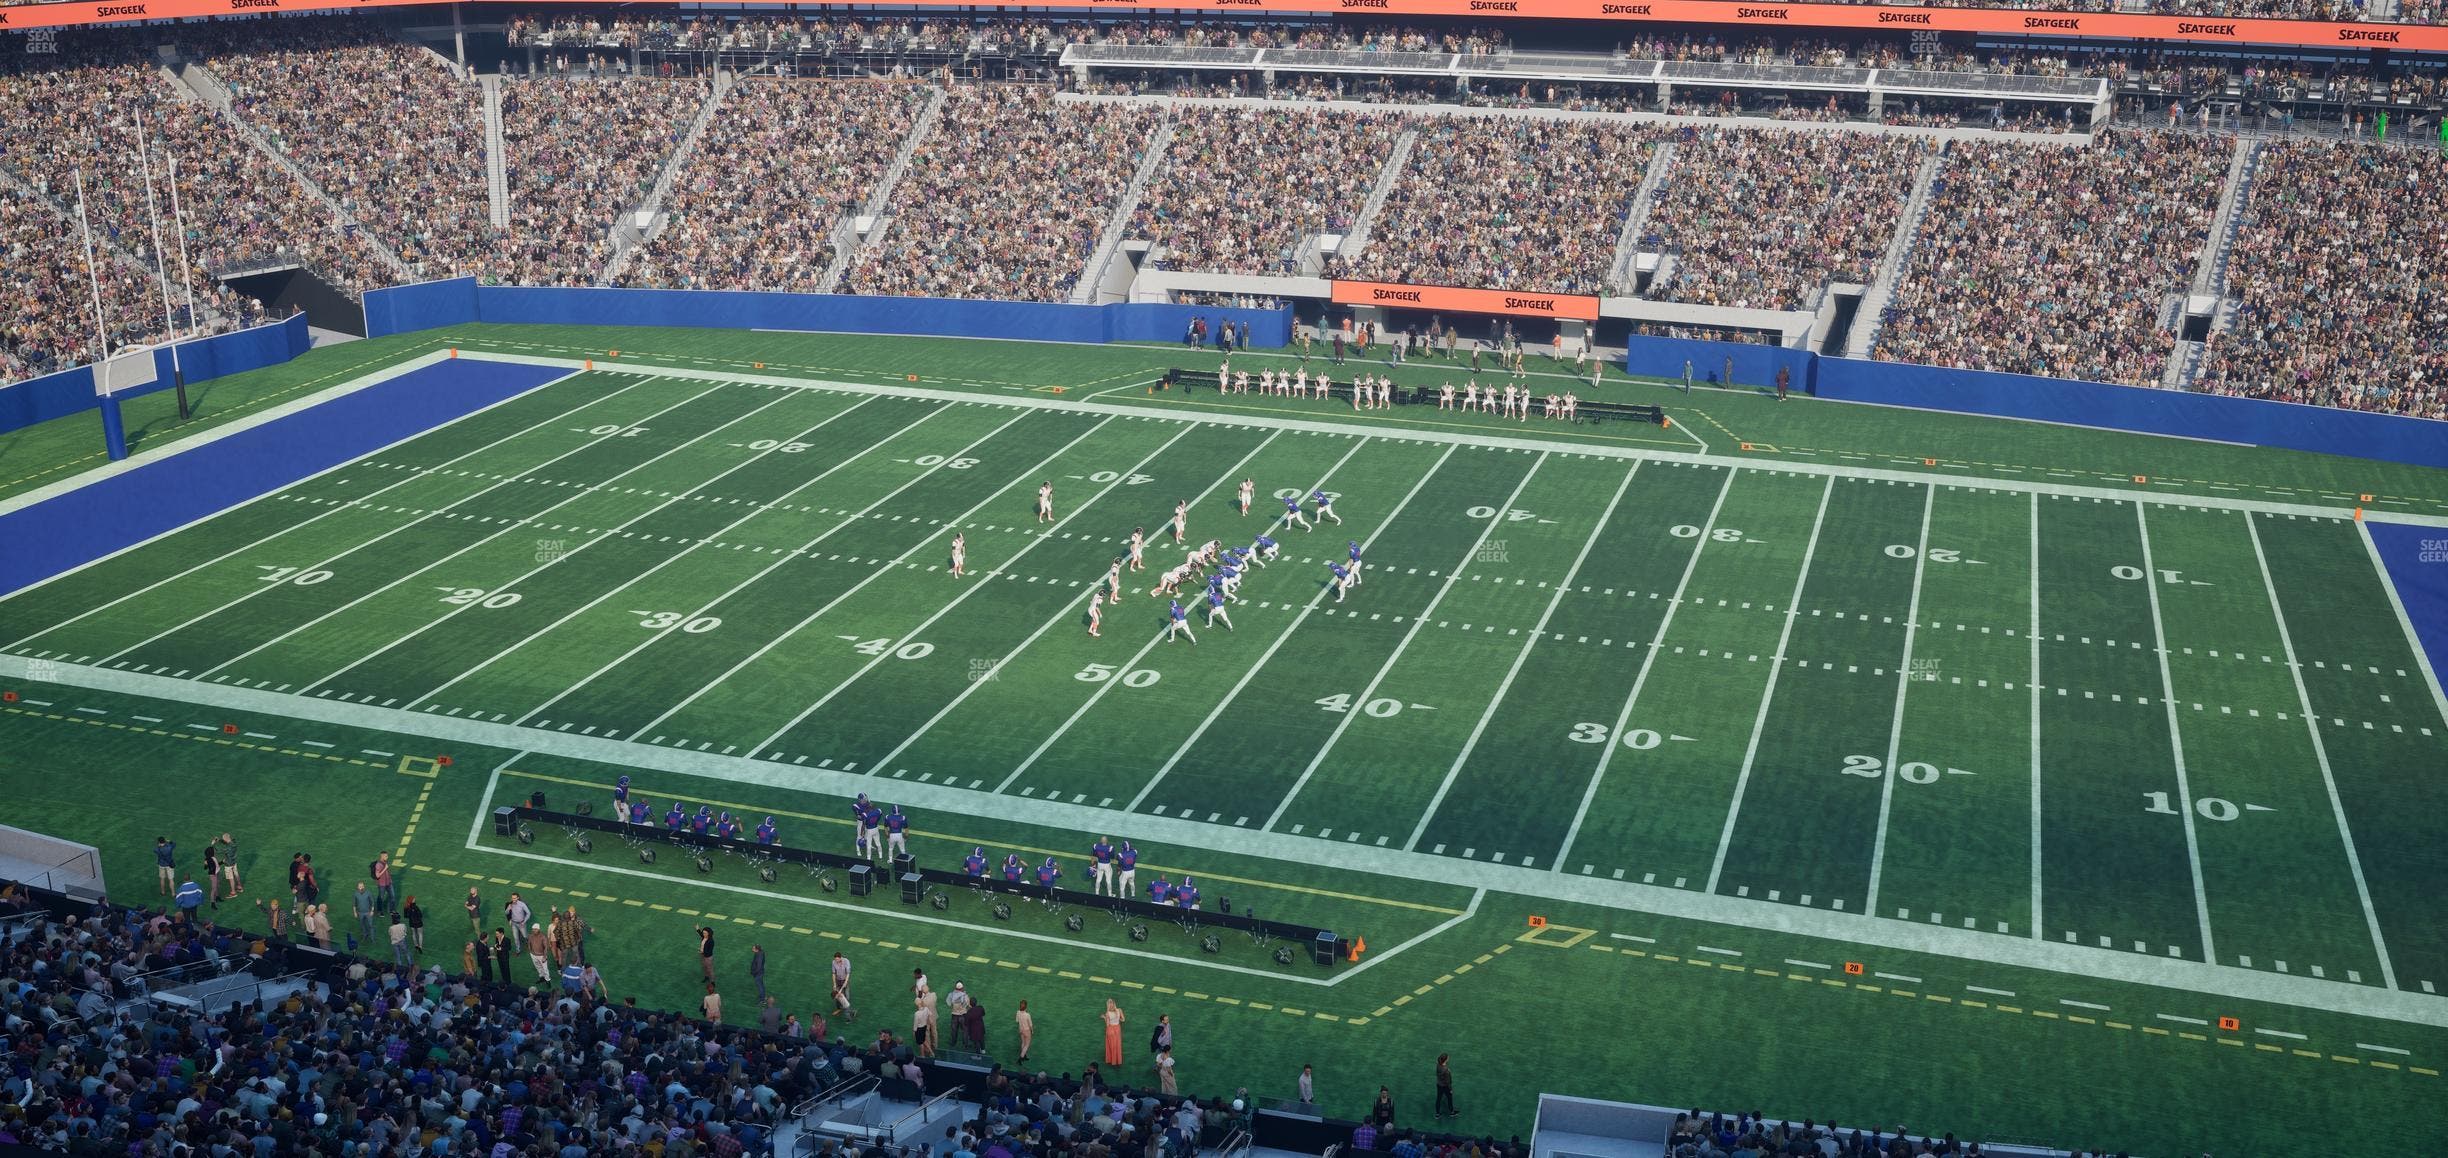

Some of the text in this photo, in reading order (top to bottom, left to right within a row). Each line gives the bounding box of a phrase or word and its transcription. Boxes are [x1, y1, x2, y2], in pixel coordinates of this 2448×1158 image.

[97, 4, 146, 17] SEATGEEK
[1342, 0, 1388, 8] SEATGEEK
[1470, 0, 1517, 11] SEATGEEK
[1602, 4, 1651, 15] SEATGEEK
[1737, 7, 1788, 19] SEATGEEK
[1878, 12, 1931, 24] SEATGEEK
[2024, 17, 2079, 30] SEATGEEK
[2178, 22, 2235, 36] SEATGEEK
[2339, 29, 2400, 43] SEATGEEK
[1373, 288, 1421, 302] SEATGEEK
[1505, 297, 1554, 312] SEATGEEK
[1670, 525, 1743, 542] 30
[1884, 544, 1960, 562] 20
[258, 567, 334, 585] 10
[438, 588, 522, 608] 20
[640, 612, 722, 633] 30
[854, 638, 935, 659] 40
[1074, 663, 1161, 688] 50
[1314, 693, 1403, 718] 40
[1568, 722, 1661, 750] 30
[1841, 755, 1940, 784] 20
[2143, 791, 2239, 821] 10
[1532, 917, 1542, 925] 30
[1850, 964, 1859, 972] 20
[2225, 1019, 2234, 1028] 10
